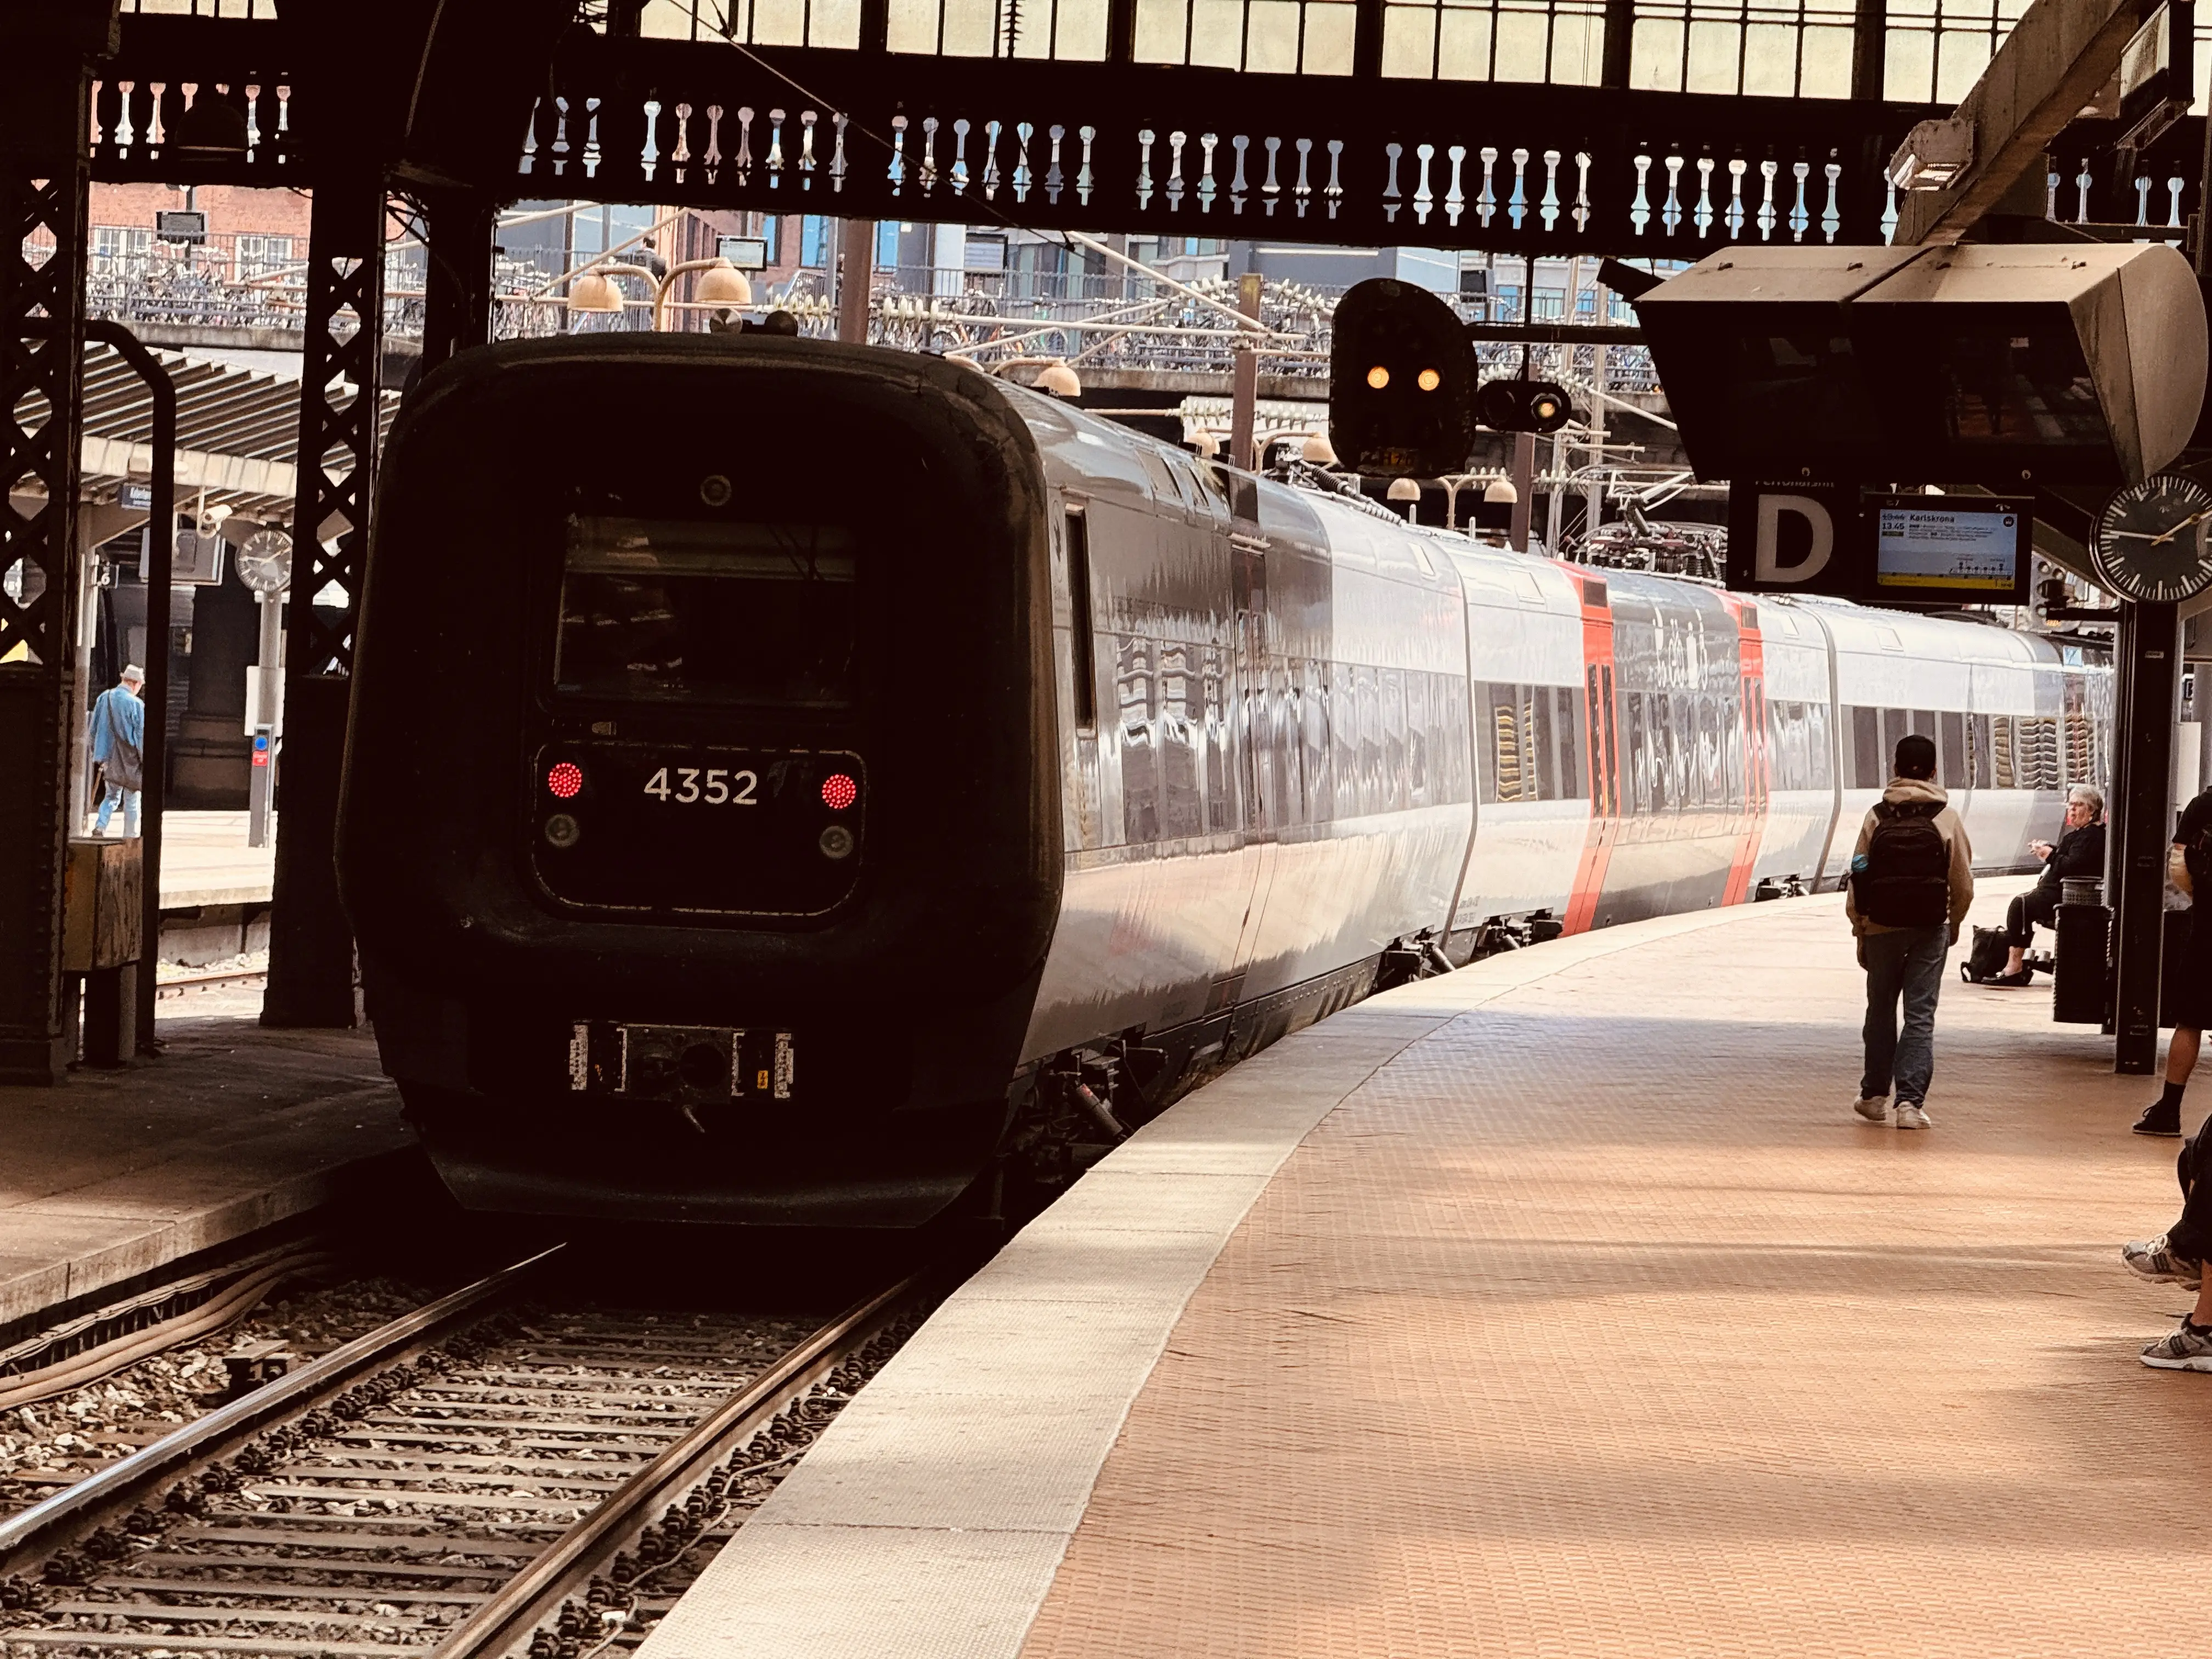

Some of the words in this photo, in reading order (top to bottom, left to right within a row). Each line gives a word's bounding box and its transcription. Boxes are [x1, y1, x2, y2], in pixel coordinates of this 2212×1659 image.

[1910, 514, 1955, 523] Karlskrona
[1755, 494, 1833, 583] D
[101, 572, 110, 585] 6
[644, 768, 757, 805] 4352
